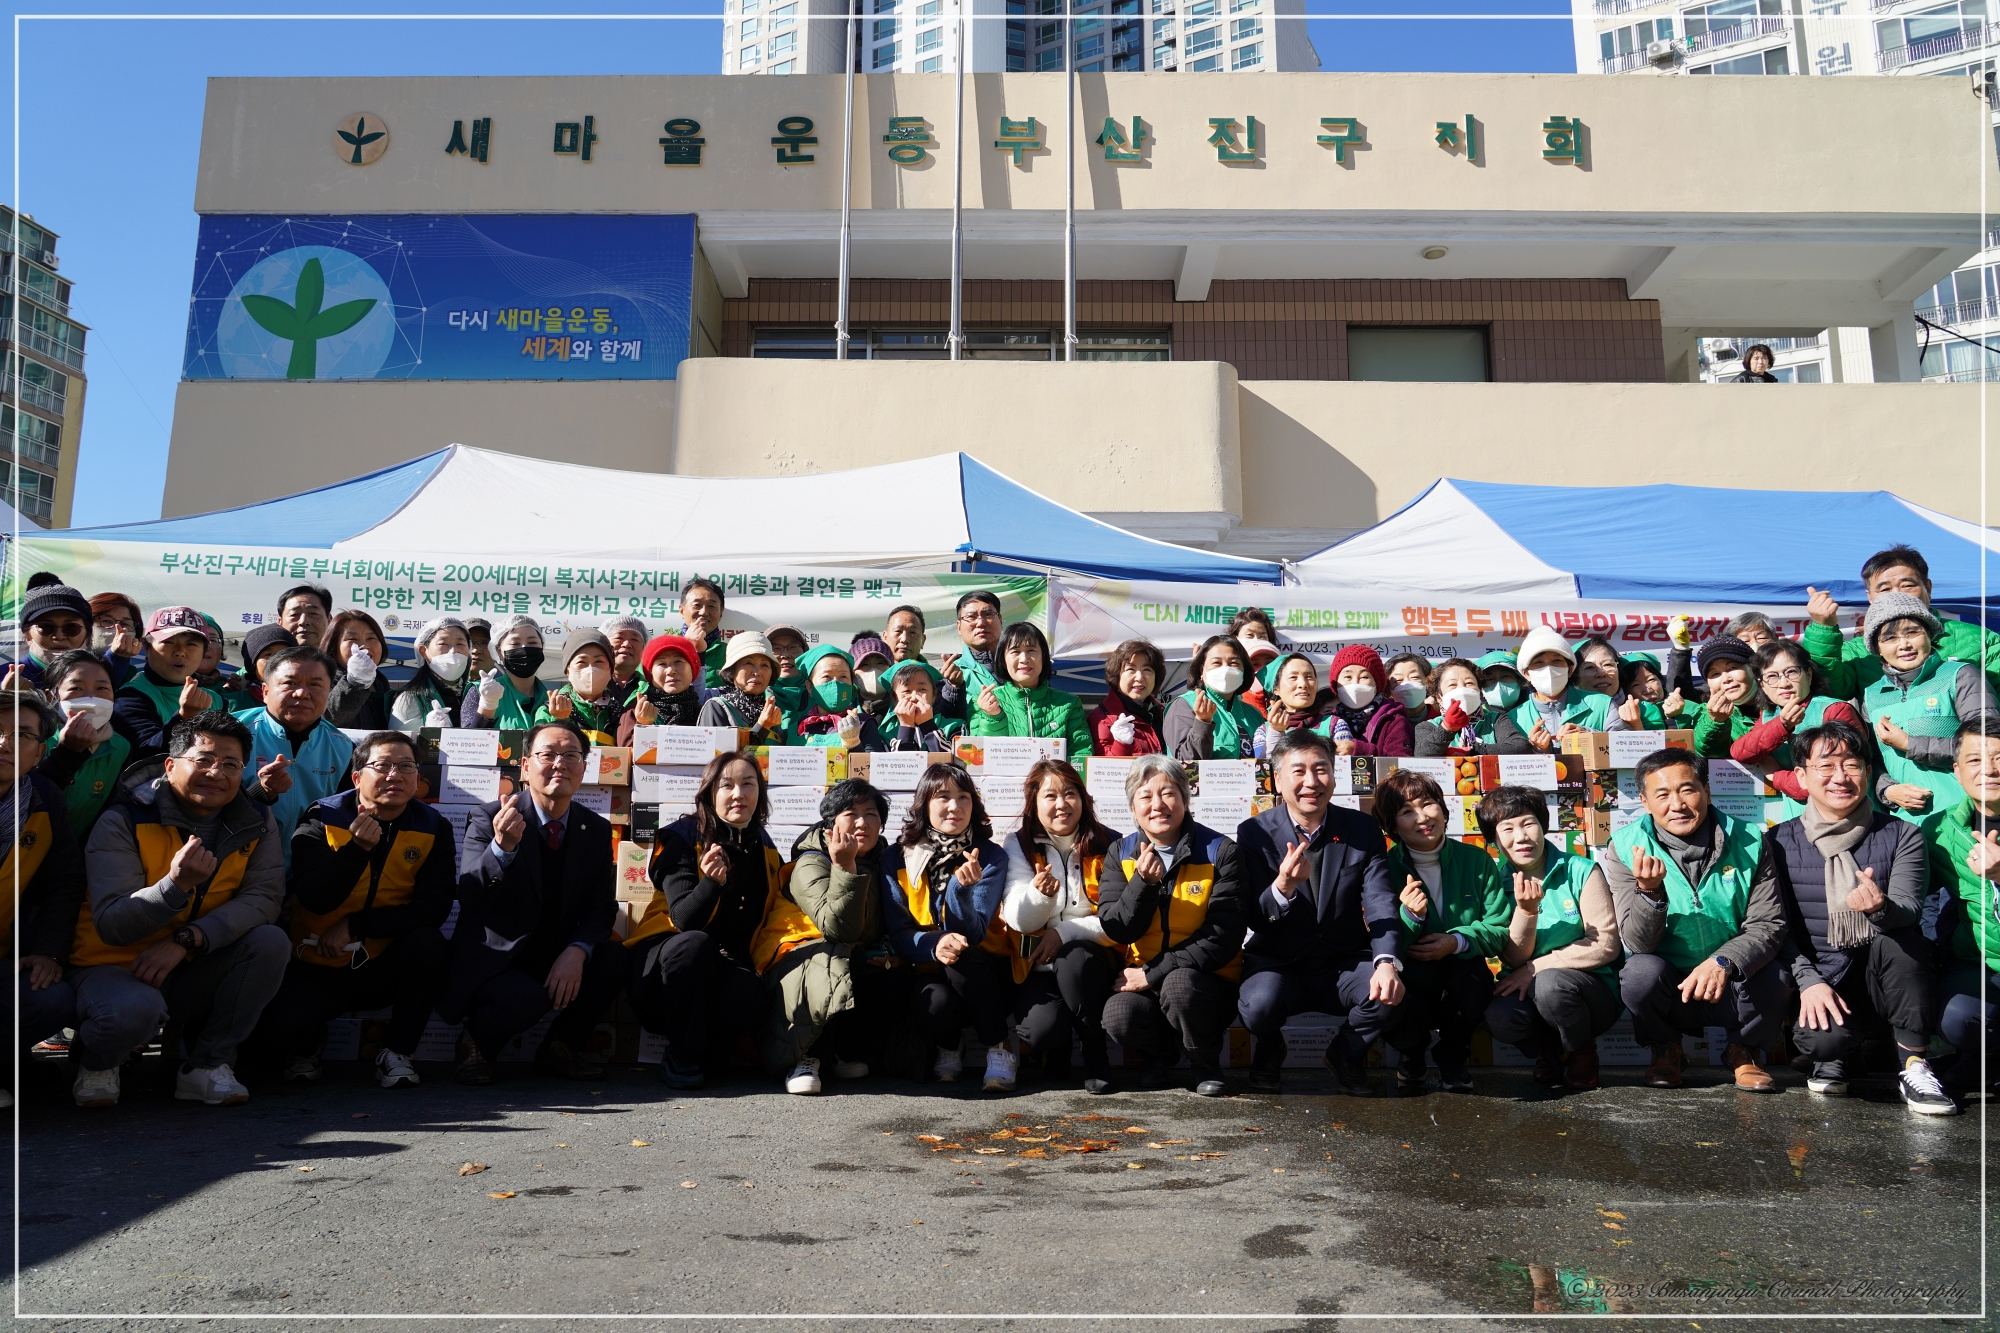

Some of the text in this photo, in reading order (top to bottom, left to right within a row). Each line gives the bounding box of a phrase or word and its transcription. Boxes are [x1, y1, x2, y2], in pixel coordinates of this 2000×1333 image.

[448, 306, 619, 334] 다시 새마을운동,
[520, 335, 642, 362] 세계와 함께
[160, 552, 437, 584] 부산진구새마을부녀회에서는
[443, 564, 548, 587] 200세대의
[555, 567, 680, 592] 복지사각지대
[796, 577, 856, 599] 결연을
[863, 579, 902, 599] 맺고
[352, 587, 414, 610] 다양한
[421, 589, 462, 612] 지원
[469, 591, 531, 614] 사업을
[539, 594, 620, 617] 전개하고
[241, 613, 263, 624] 후원
[1185, 605, 1280, 628] 새마을,
[1286, 608, 1340, 629] 세계와
[1402, 606, 1458, 638] 행복
[1467, 609, 1494, 638] 두
[1501, 610, 1529, 638] 배
